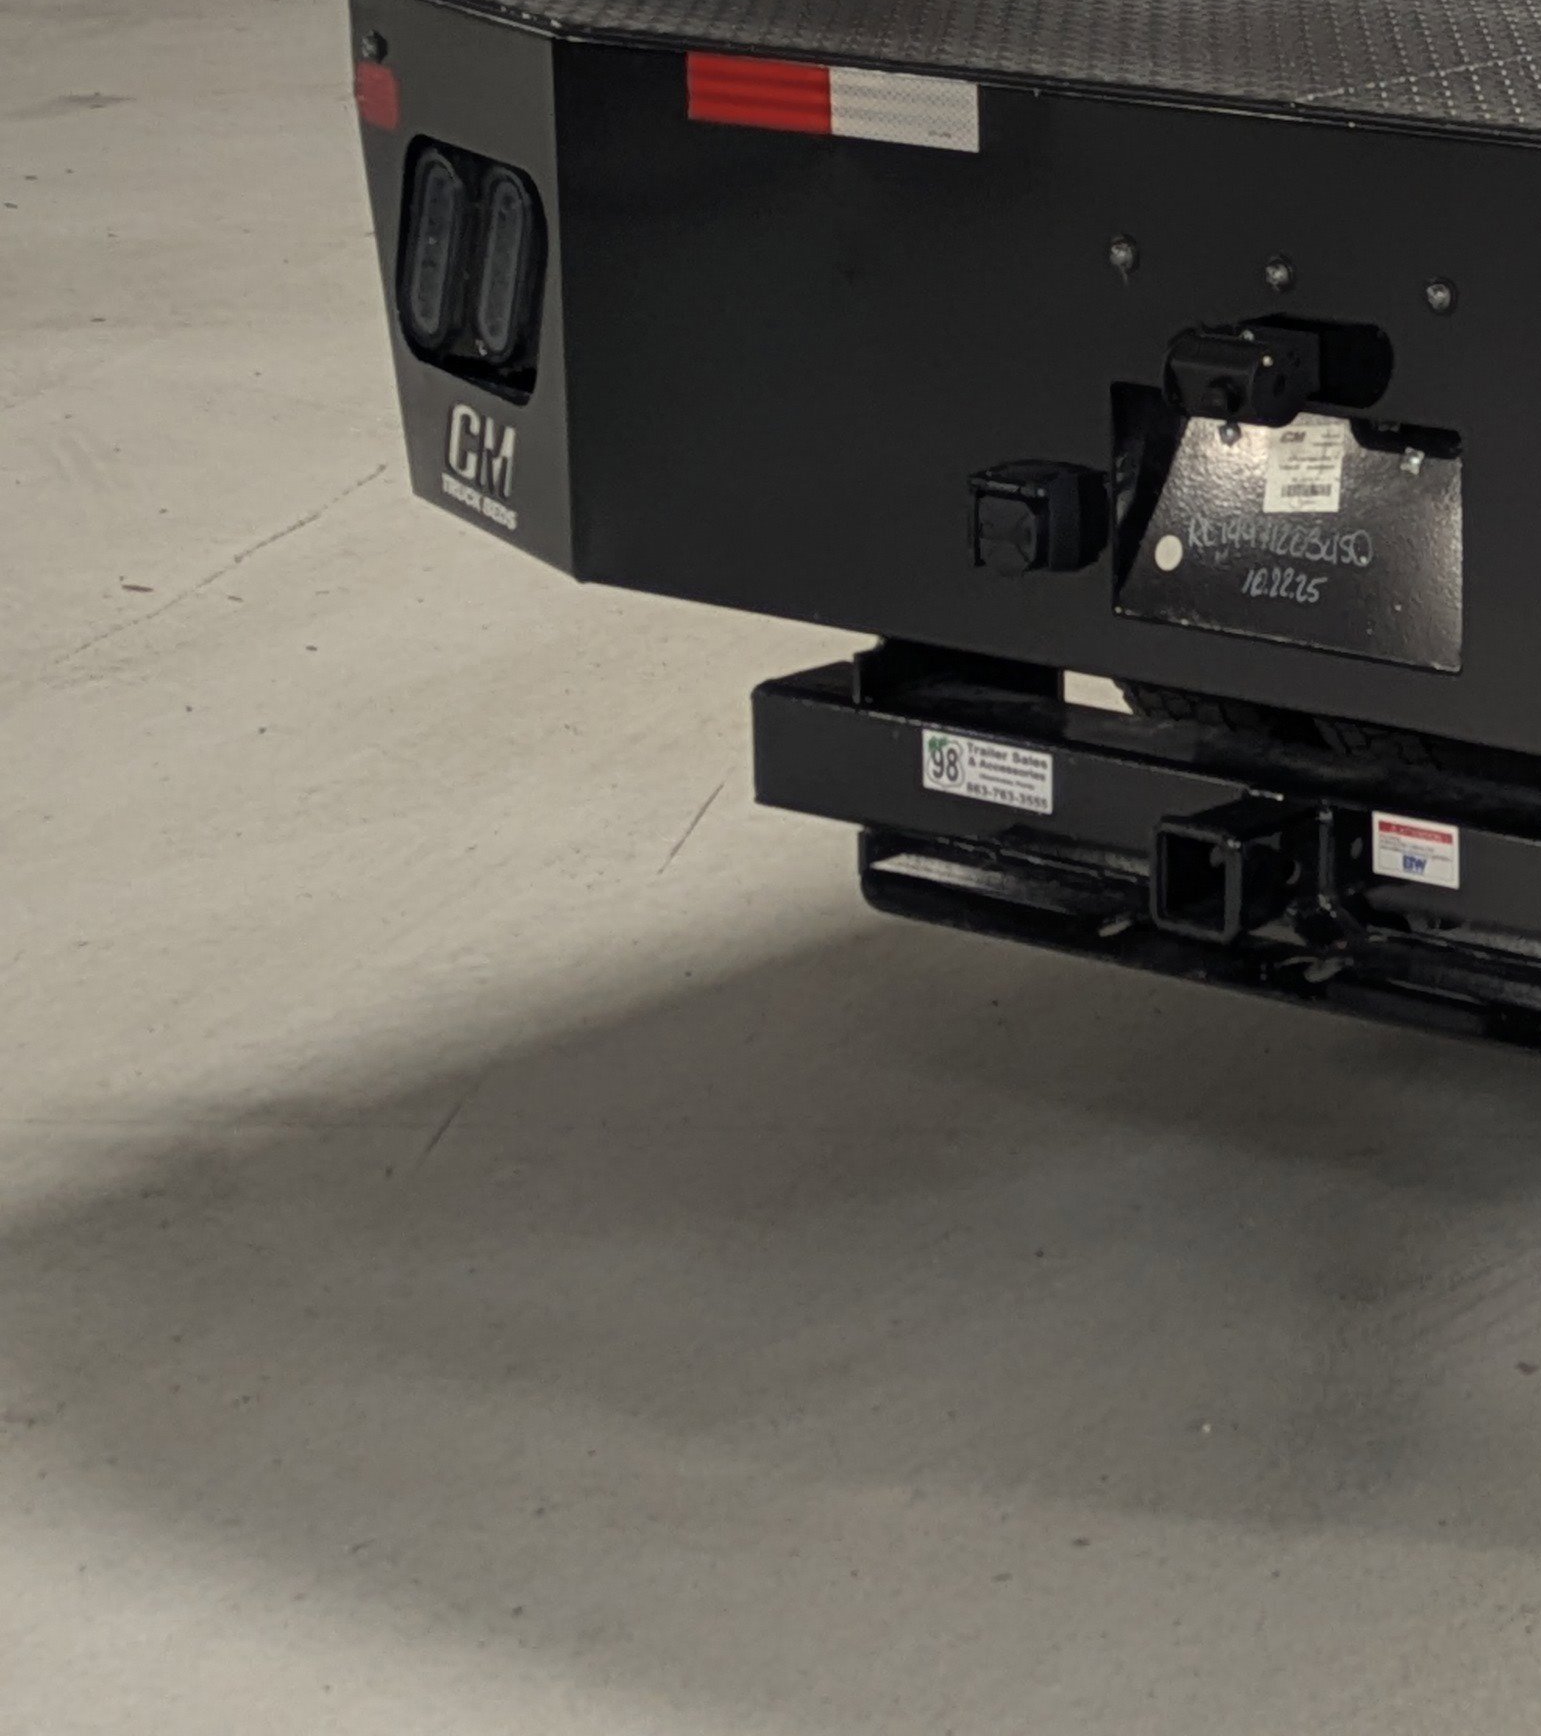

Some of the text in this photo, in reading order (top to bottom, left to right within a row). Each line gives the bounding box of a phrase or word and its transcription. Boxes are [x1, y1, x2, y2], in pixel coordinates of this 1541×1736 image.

[449, 402, 516, 498] CM
[929, 747, 960, 783] 98
[966, 741, 1049, 769] Trailer Sales
